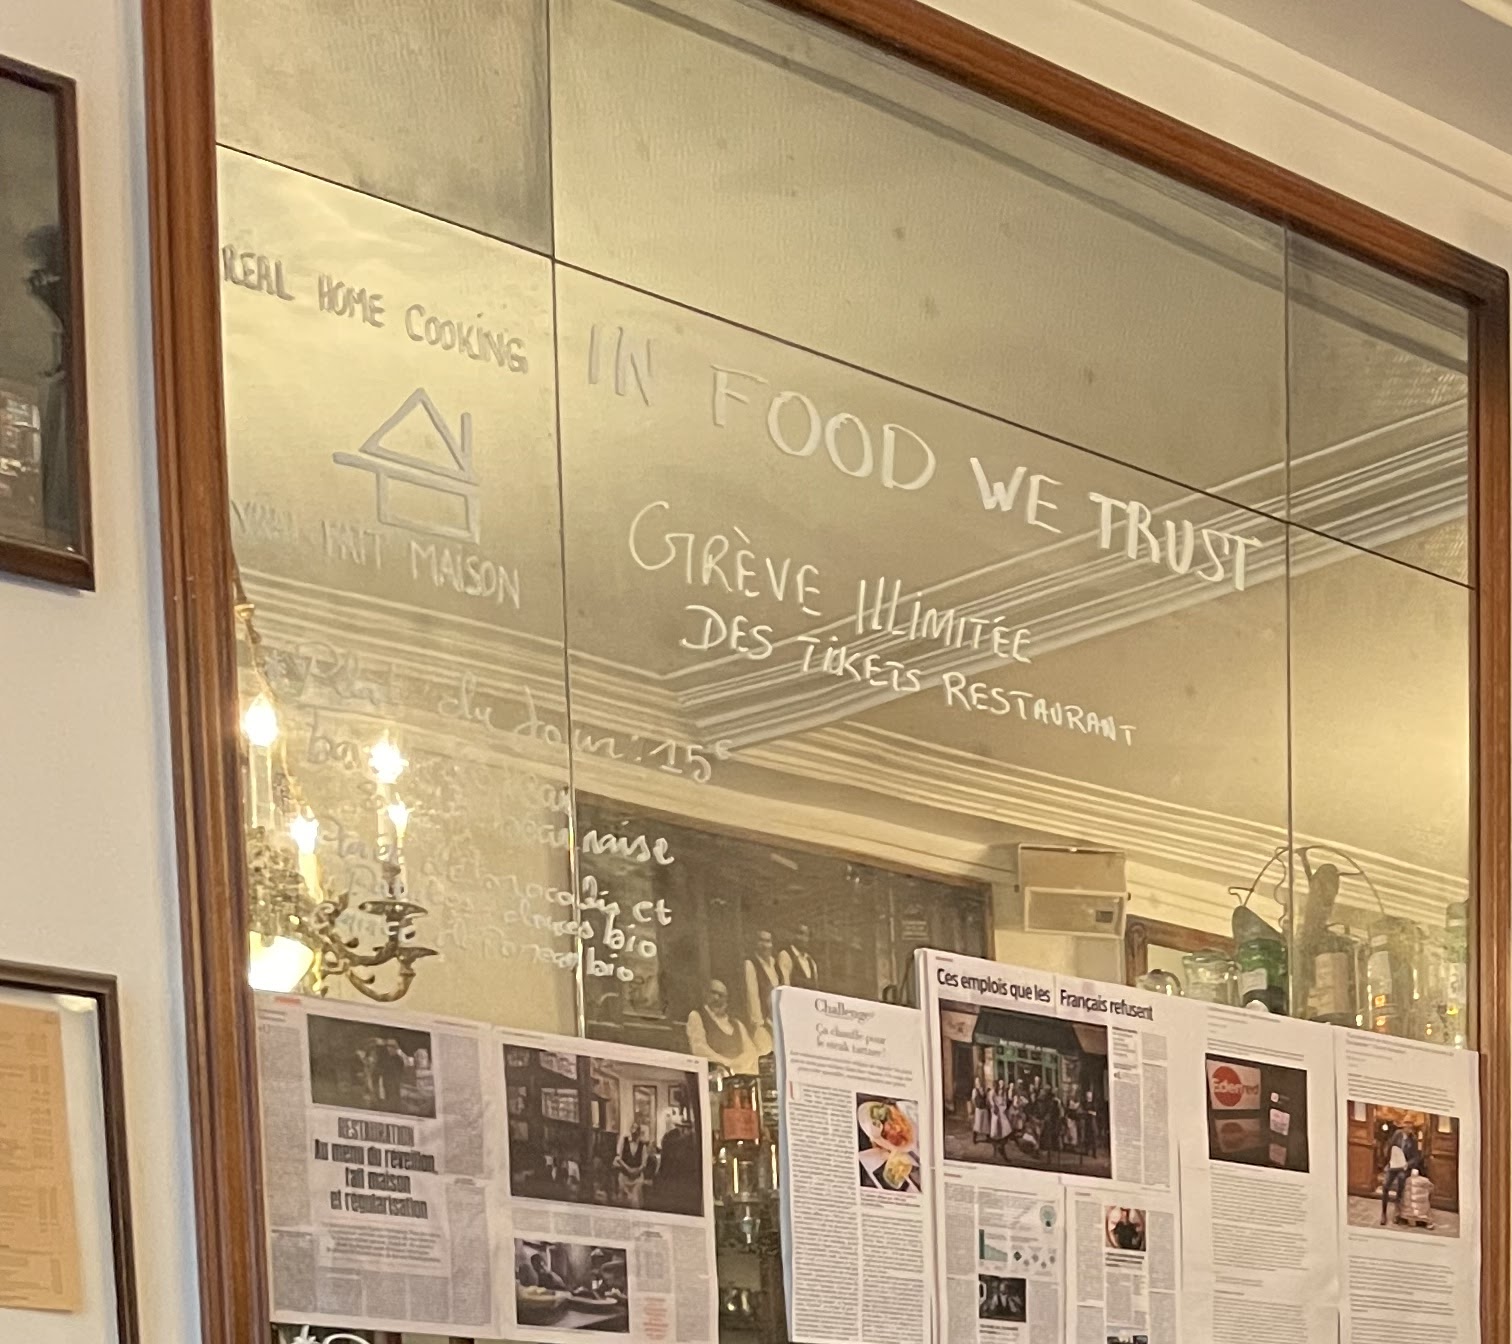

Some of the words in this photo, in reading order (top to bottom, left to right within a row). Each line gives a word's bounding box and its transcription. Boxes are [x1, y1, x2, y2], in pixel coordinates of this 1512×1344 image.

[222, 243, 296, 301] REAL
[318, 272, 386, 328] HOME
[587, 324, 653, 406] IN
[709, 364, 936, 490] FOOD
[969, 456, 1063, 534] WE
[1089, 492, 1263, 591] TRUST
[629, 500, 821, 616] GRÈVE
[438, 671, 497, 732] du
[680, 605, 773, 660] DES
[942, 671, 1137, 746] RESTAURANT
[602, 912, 658, 958] bio
[632, 898, 673, 926] et
[585, 946, 635, 982] bio
[937, 968, 958, 988] Ces
[960, 976, 1009, 996] emplois
[1010, 982, 1033, 1001] que
[1034, 984, 1052, 1003] les
[1060, 989, 1109, 1013] Français
[1109, 998, 1155, 1022] refusent
